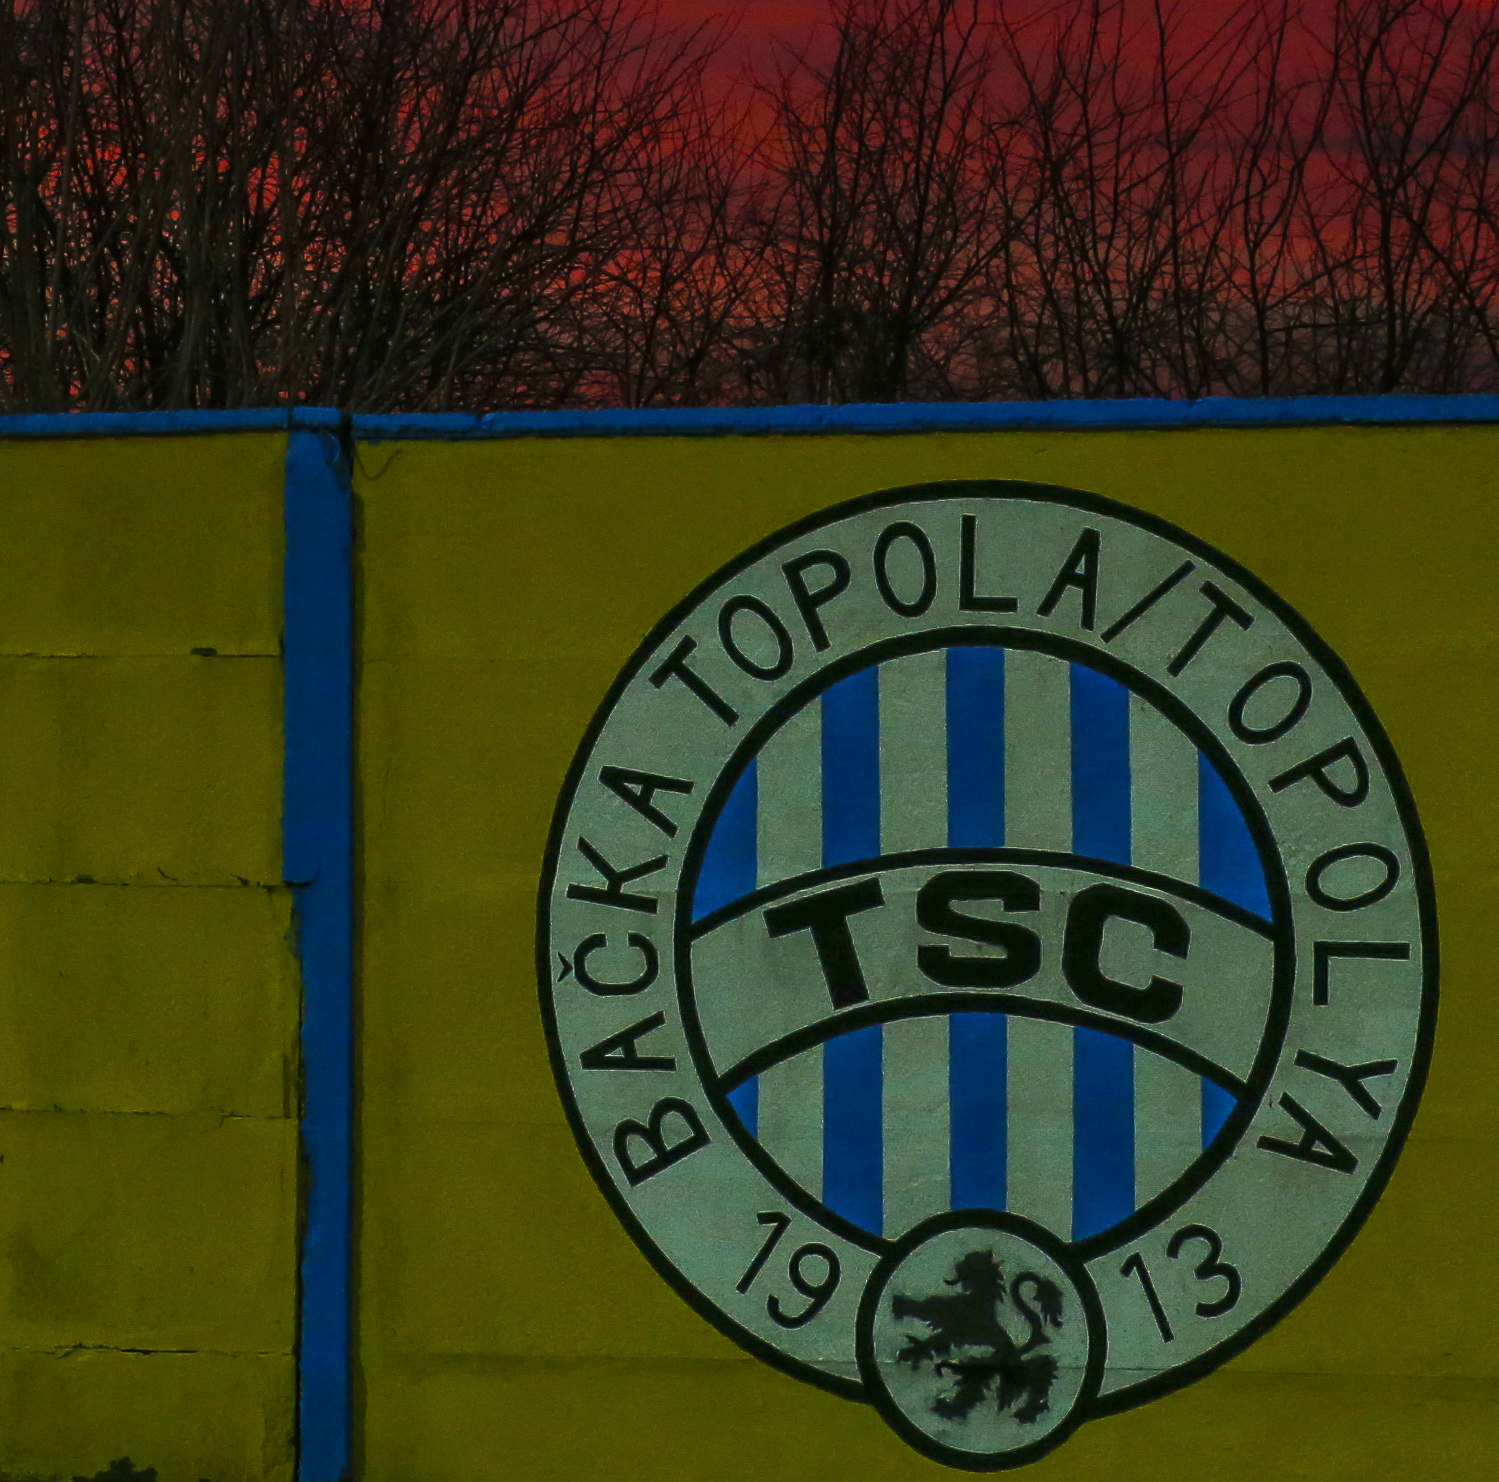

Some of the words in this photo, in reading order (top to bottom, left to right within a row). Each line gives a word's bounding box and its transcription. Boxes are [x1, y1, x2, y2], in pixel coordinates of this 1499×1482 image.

[557, 764, 712, 1187] BAČKA
[763, 869, 1192, 1025] TSC
[735, 1210, 842, 1330] 19
[1119, 1223, 1242, 1344] 13
